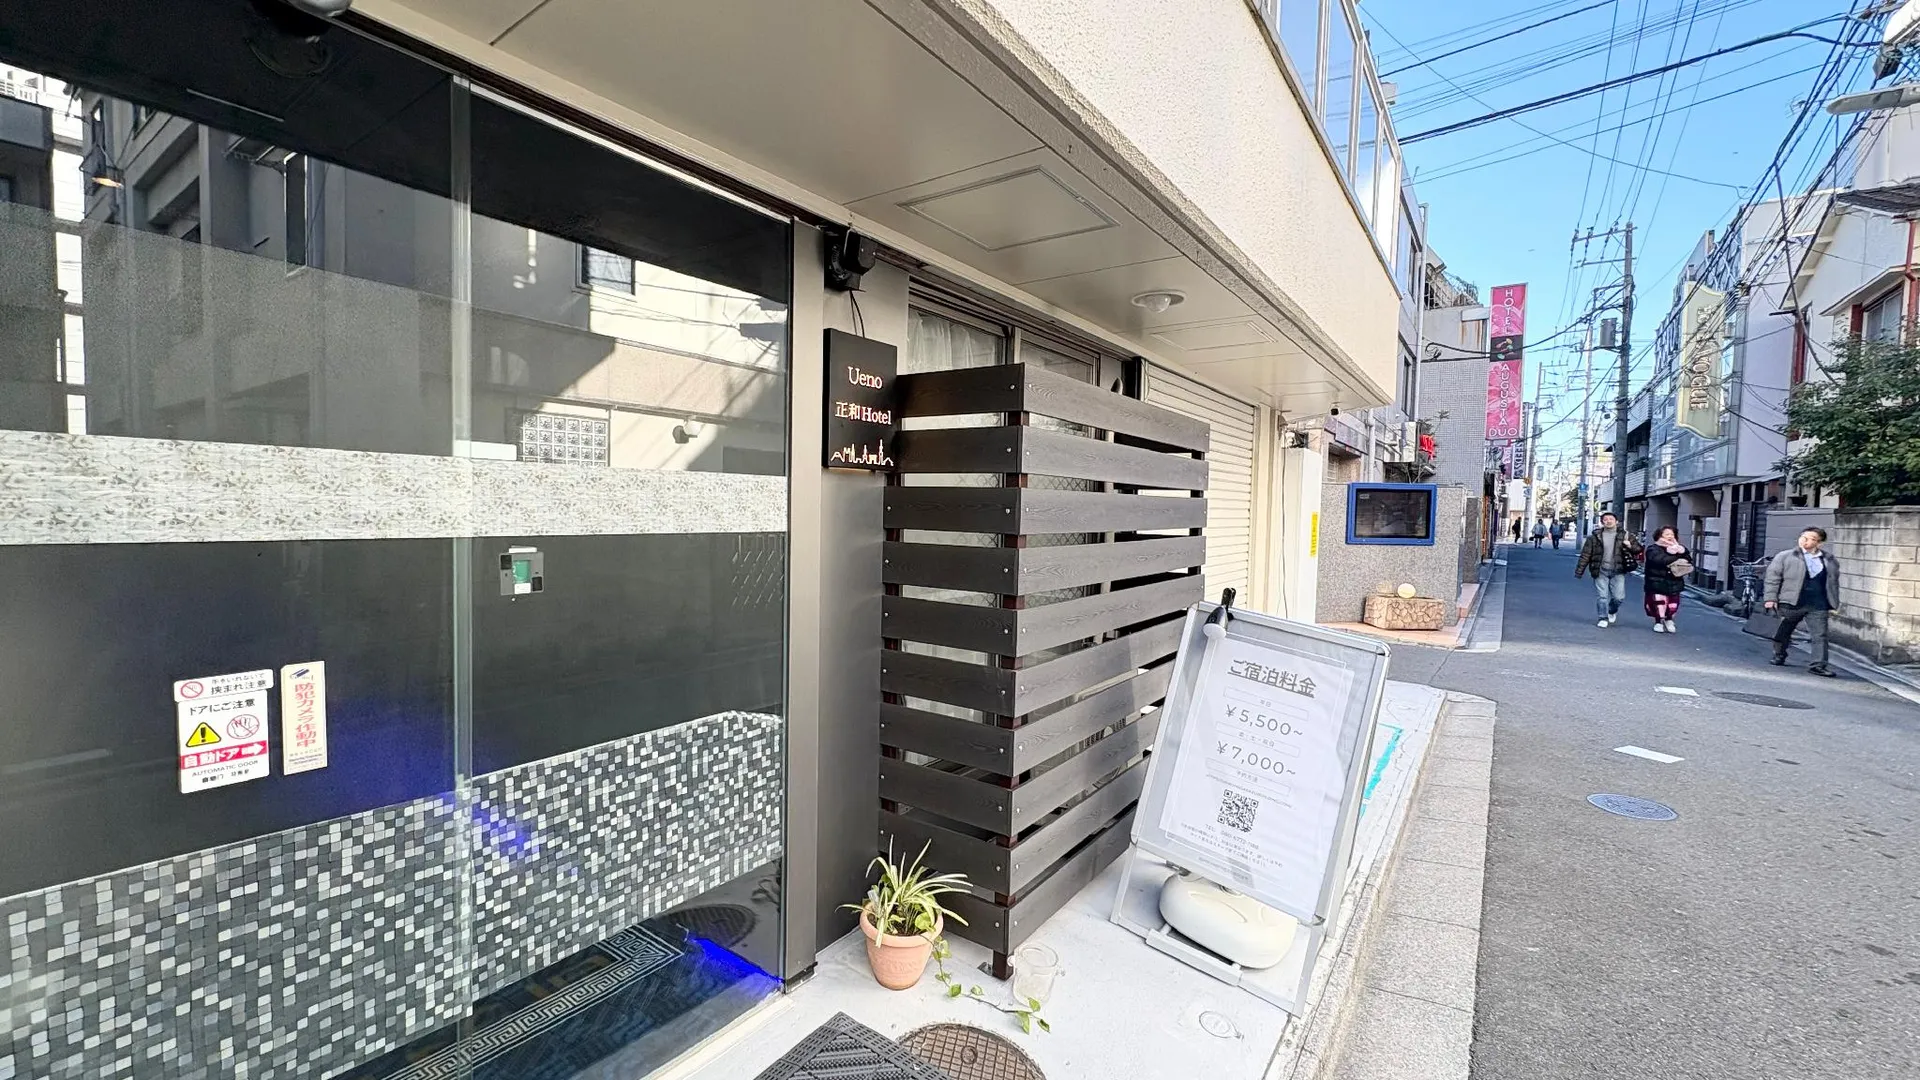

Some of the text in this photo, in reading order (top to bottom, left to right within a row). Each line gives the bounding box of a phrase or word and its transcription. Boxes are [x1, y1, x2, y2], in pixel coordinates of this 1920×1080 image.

[1504, 289, 1514, 335] HOTEL
[847, 366, 883, 389] Ueno
[1689, 348, 1712, 412] VOGUE
[1500, 362, 1511, 426] AUGUSTA
[1489, 427, 1518, 438] DUO
[1228, 659, 1317, 698] ご宿泊料金
[190, 698, 255, 716] ドアにご注意
[294, 682, 316, 748] 防犯カメラ作動中
[184, 748, 240, 768] 自動ドア
[192, 763, 236, 776] AUTOMATIC
[238, 760, 259, 769] DOOR
